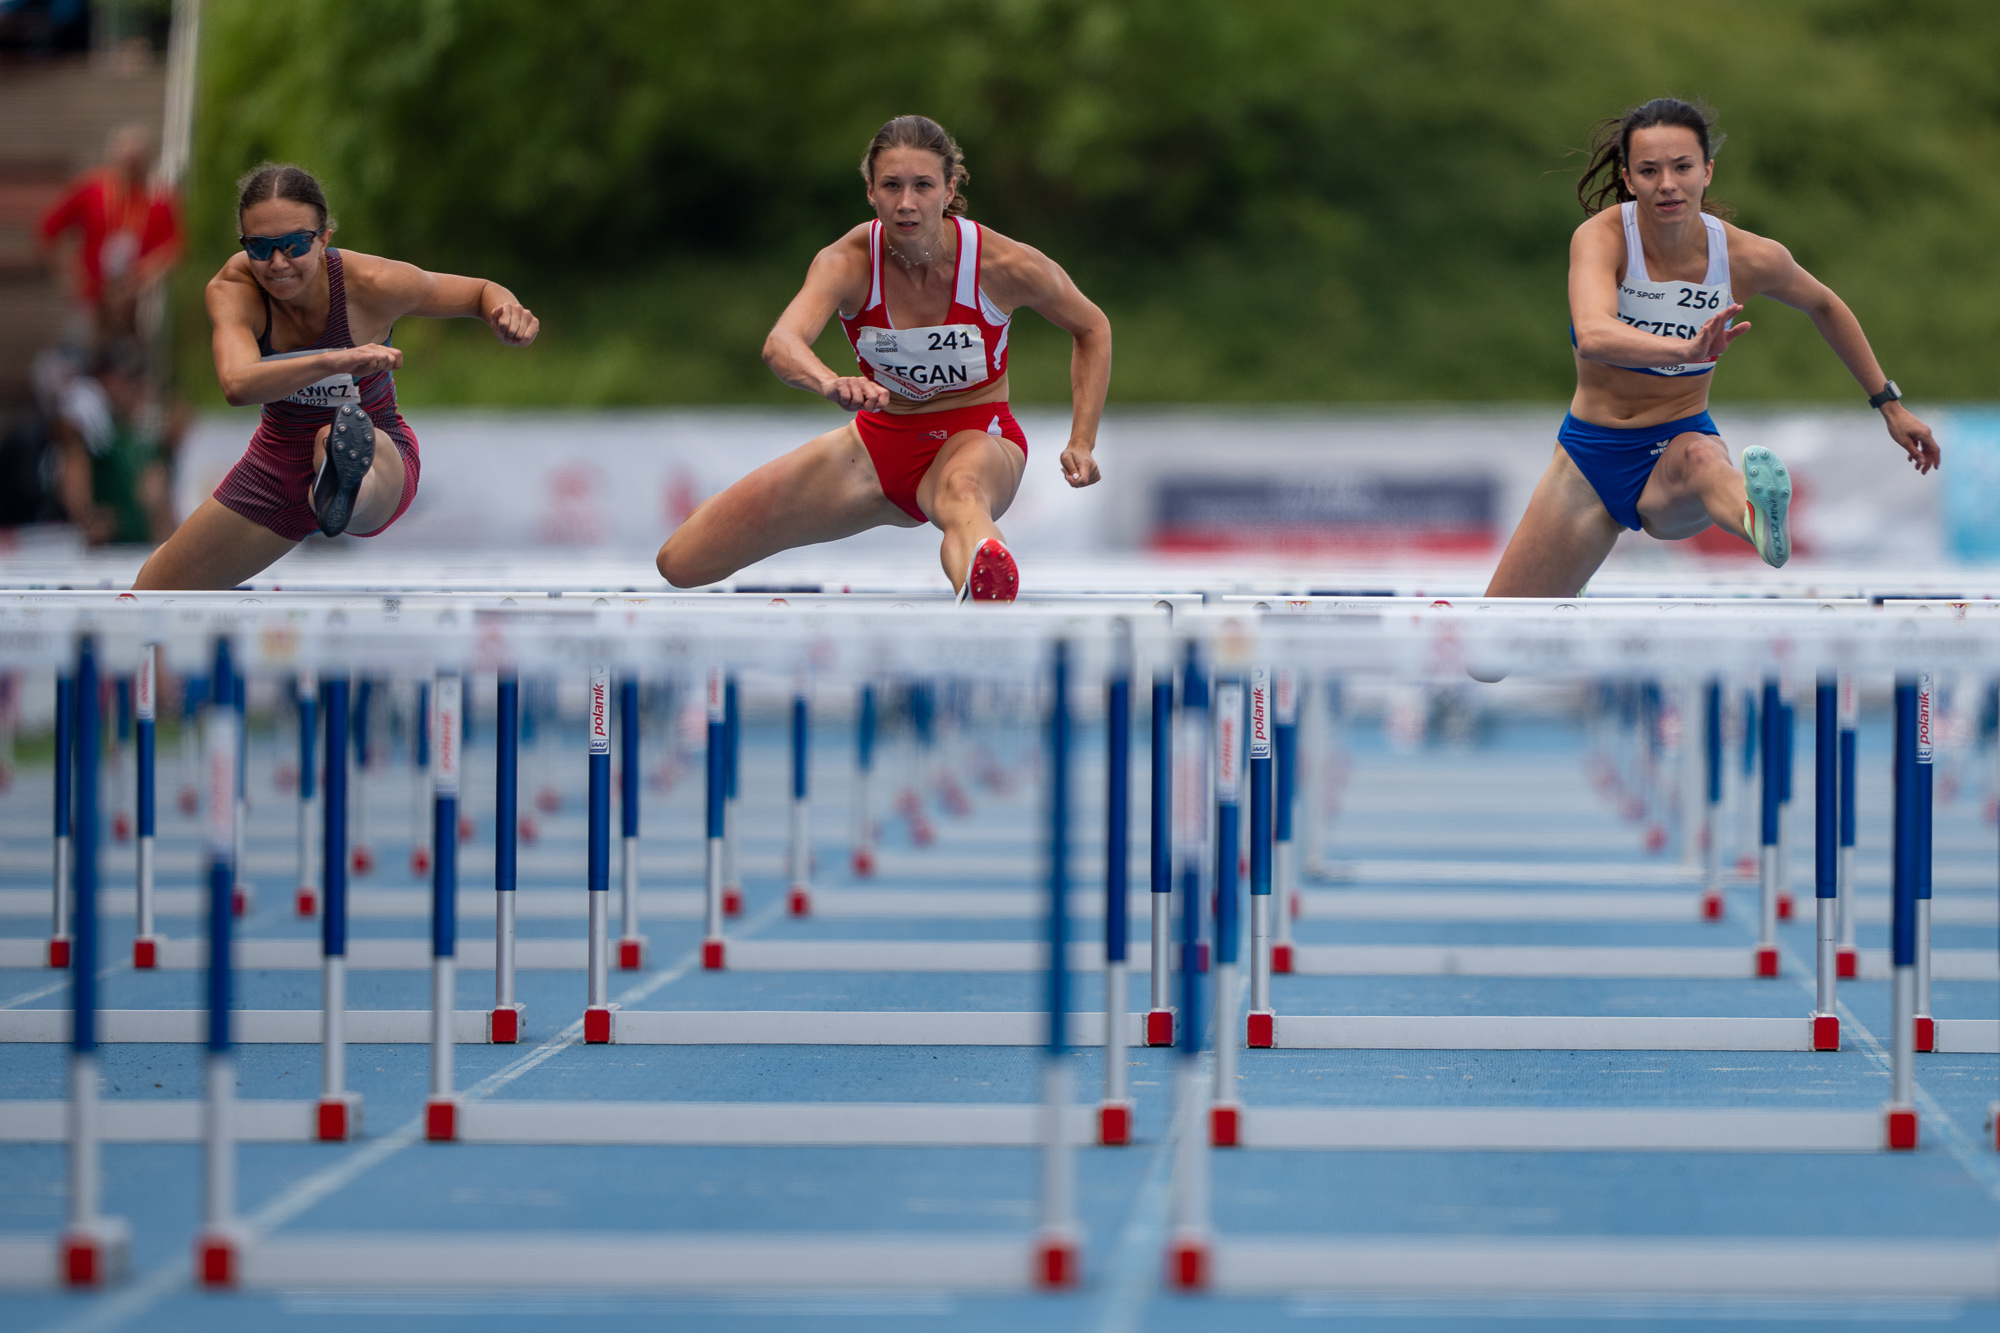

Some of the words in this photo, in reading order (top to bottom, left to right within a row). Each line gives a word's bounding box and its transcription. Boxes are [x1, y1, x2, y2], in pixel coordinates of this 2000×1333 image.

[1636, 290, 1666, 300] SPORT
[1677, 287, 1720, 309] 256
[927, 331, 973, 351] 241
[303, 398, 328, 406] 2023
[592, 683, 606, 737] polanik
[1253, 687, 1267, 741] polanik
[1918, 691, 1931, 745] polanik
